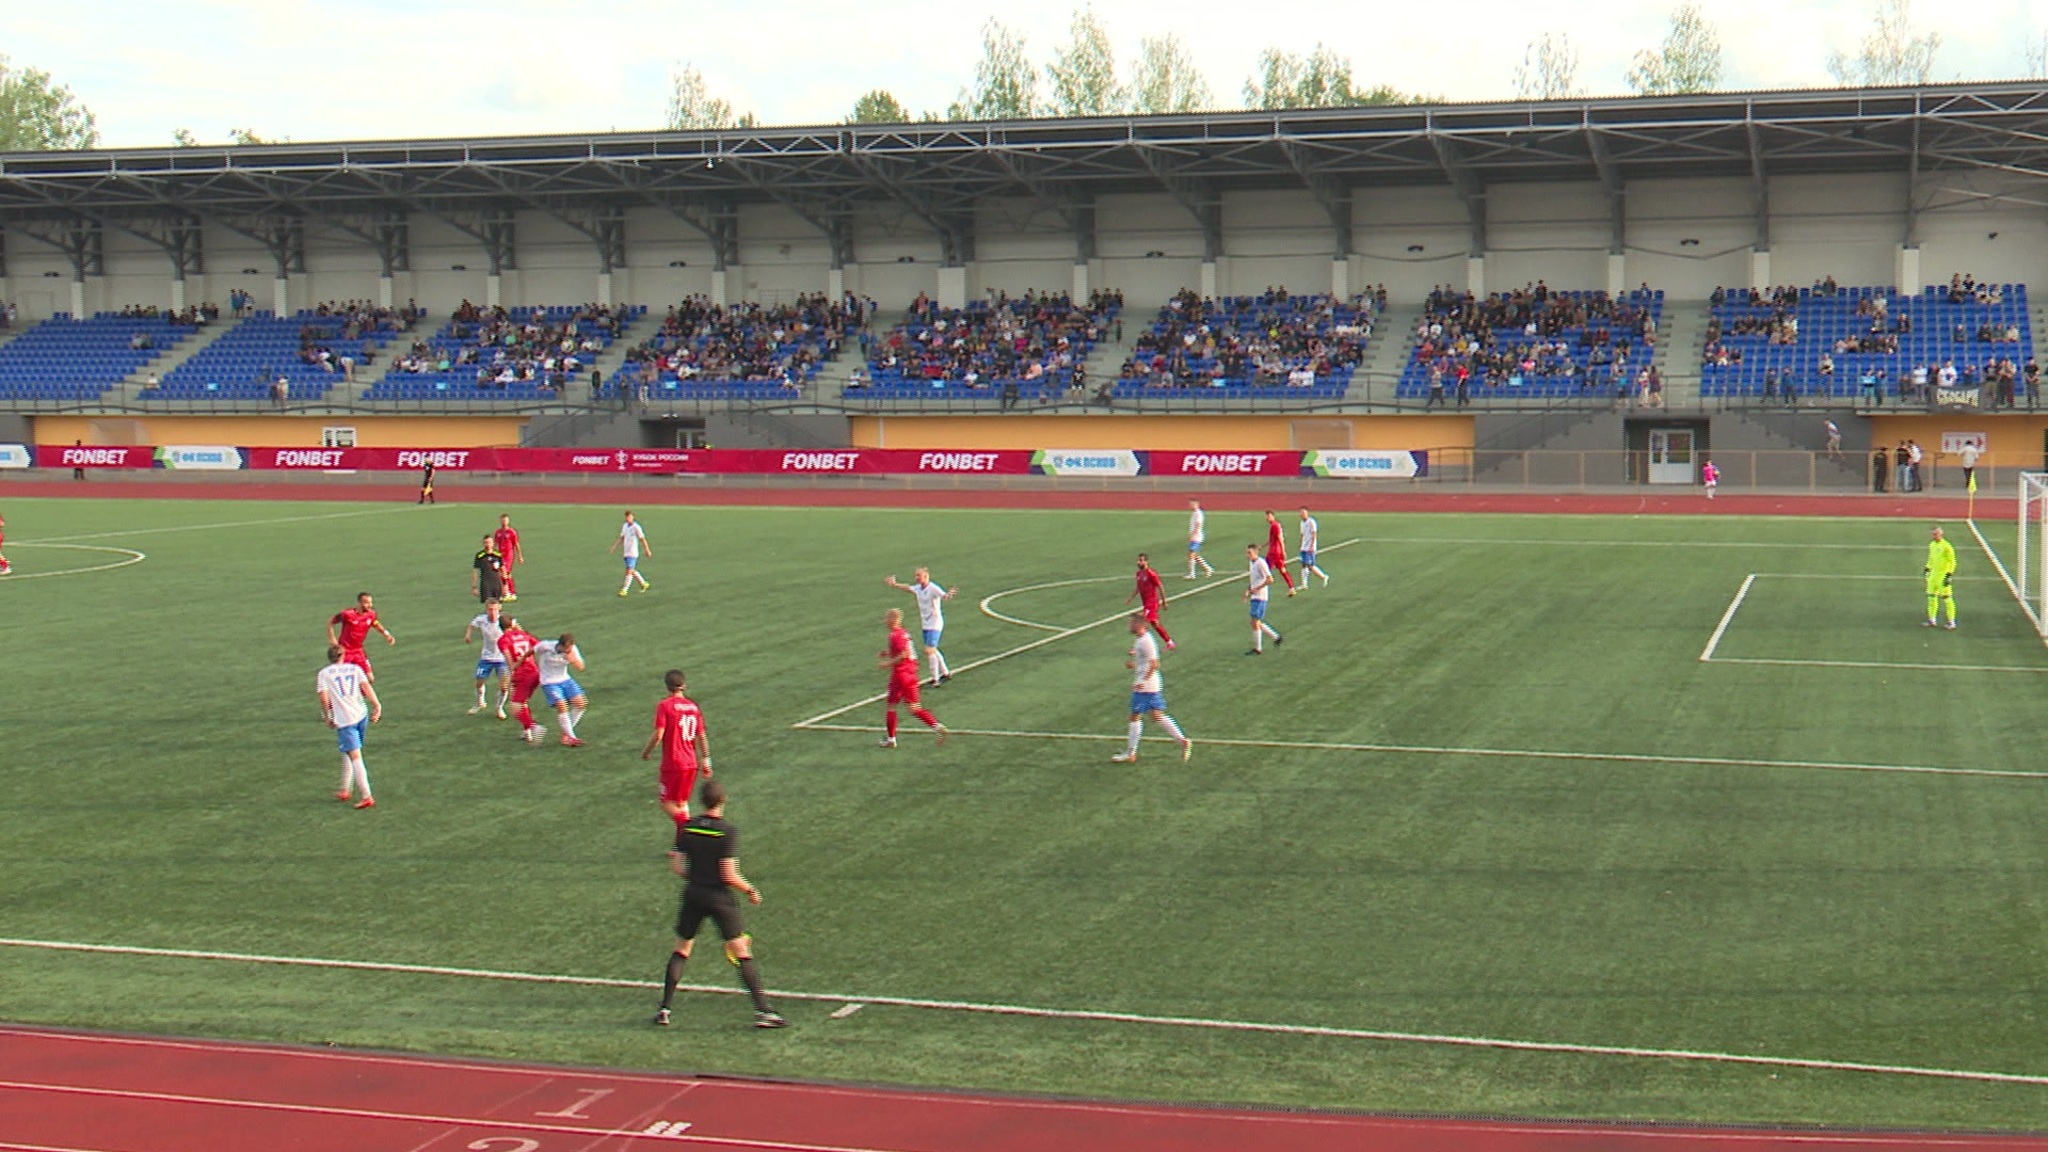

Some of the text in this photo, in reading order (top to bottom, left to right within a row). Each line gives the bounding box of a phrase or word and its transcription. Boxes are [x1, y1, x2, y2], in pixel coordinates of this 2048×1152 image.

[62, 449, 128, 464] FONBET
[275, 450, 344, 466] FONBET
[572, 455, 609, 465] FONBET
[782, 453, 859, 470] FONBET
[919, 453, 998, 470] FONBET
[1182, 455, 1266, 472] FONBET
[335, 675, 355, 697] 17
[678, 714, 697, 741] 10
[534, 1088, 615, 1119] 1
